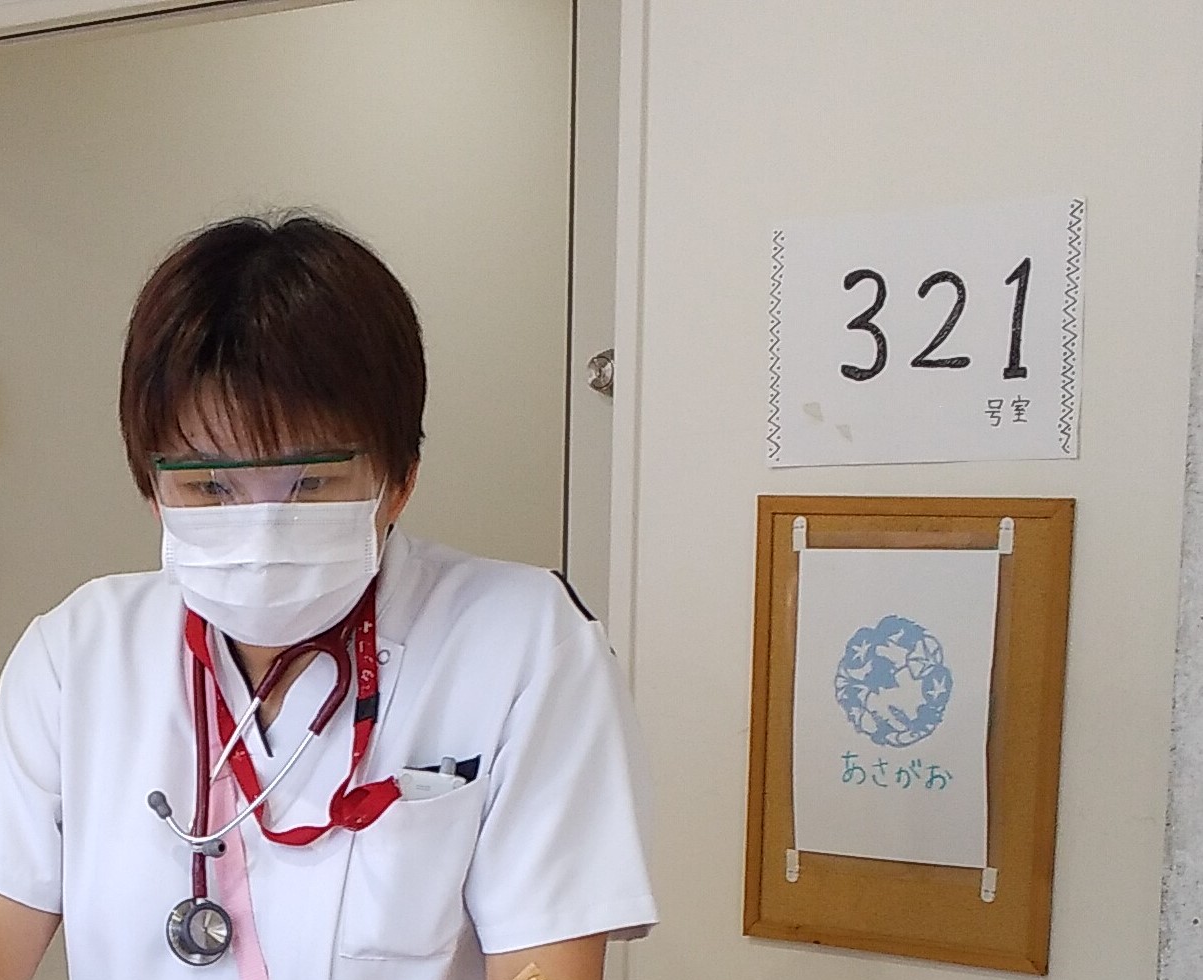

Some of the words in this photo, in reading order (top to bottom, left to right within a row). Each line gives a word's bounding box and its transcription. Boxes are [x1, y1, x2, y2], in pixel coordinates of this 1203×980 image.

[839, 256, 1032, 382] 321
[983, 395, 1031, 428] 号室
[841, 750, 954, 790] あさがお
